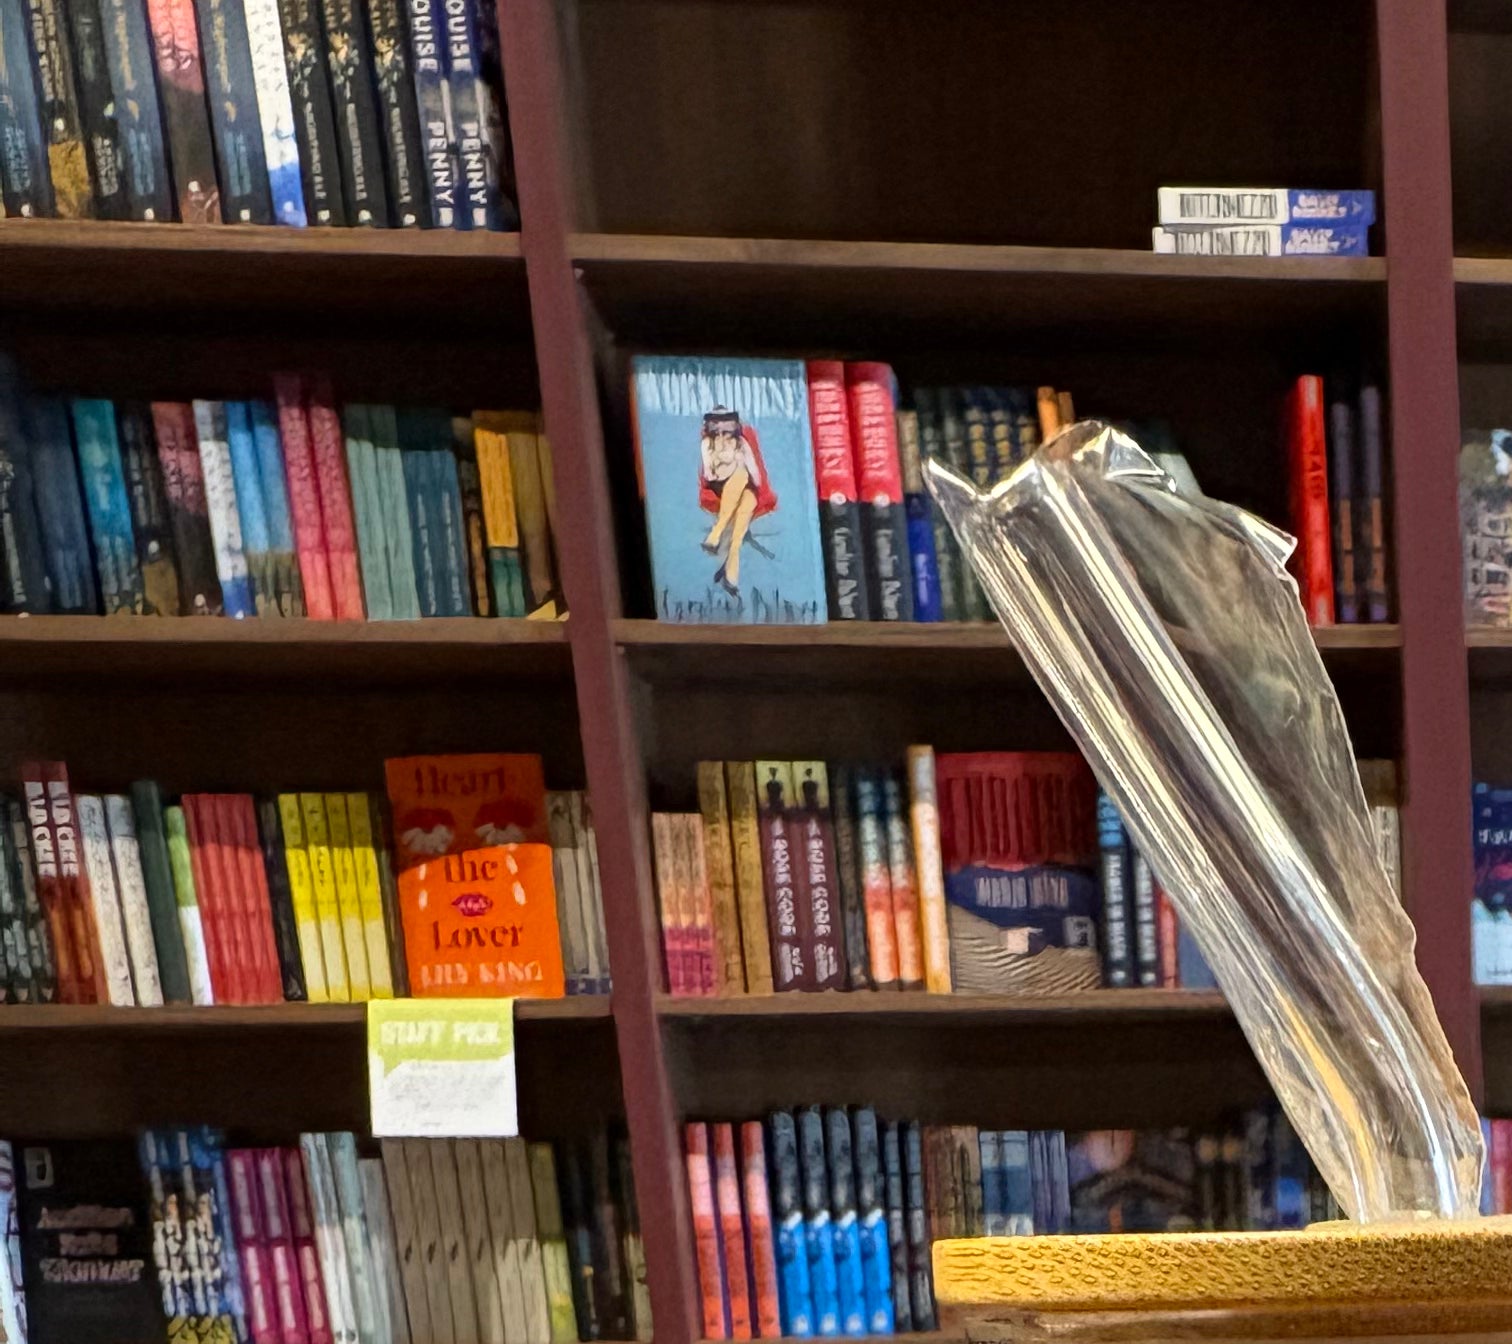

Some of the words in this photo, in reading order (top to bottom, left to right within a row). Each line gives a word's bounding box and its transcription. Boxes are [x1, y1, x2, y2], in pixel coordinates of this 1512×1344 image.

[427, 121, 455, 205] PENNY
[461, 122, 488, 205] PENNY
[444, 853, 498, 884] the
[432, 921, 524, 951] Lover
[380, 1020, 447, 1046] STAFF
[453, 1020, 500, 1045] PICK
